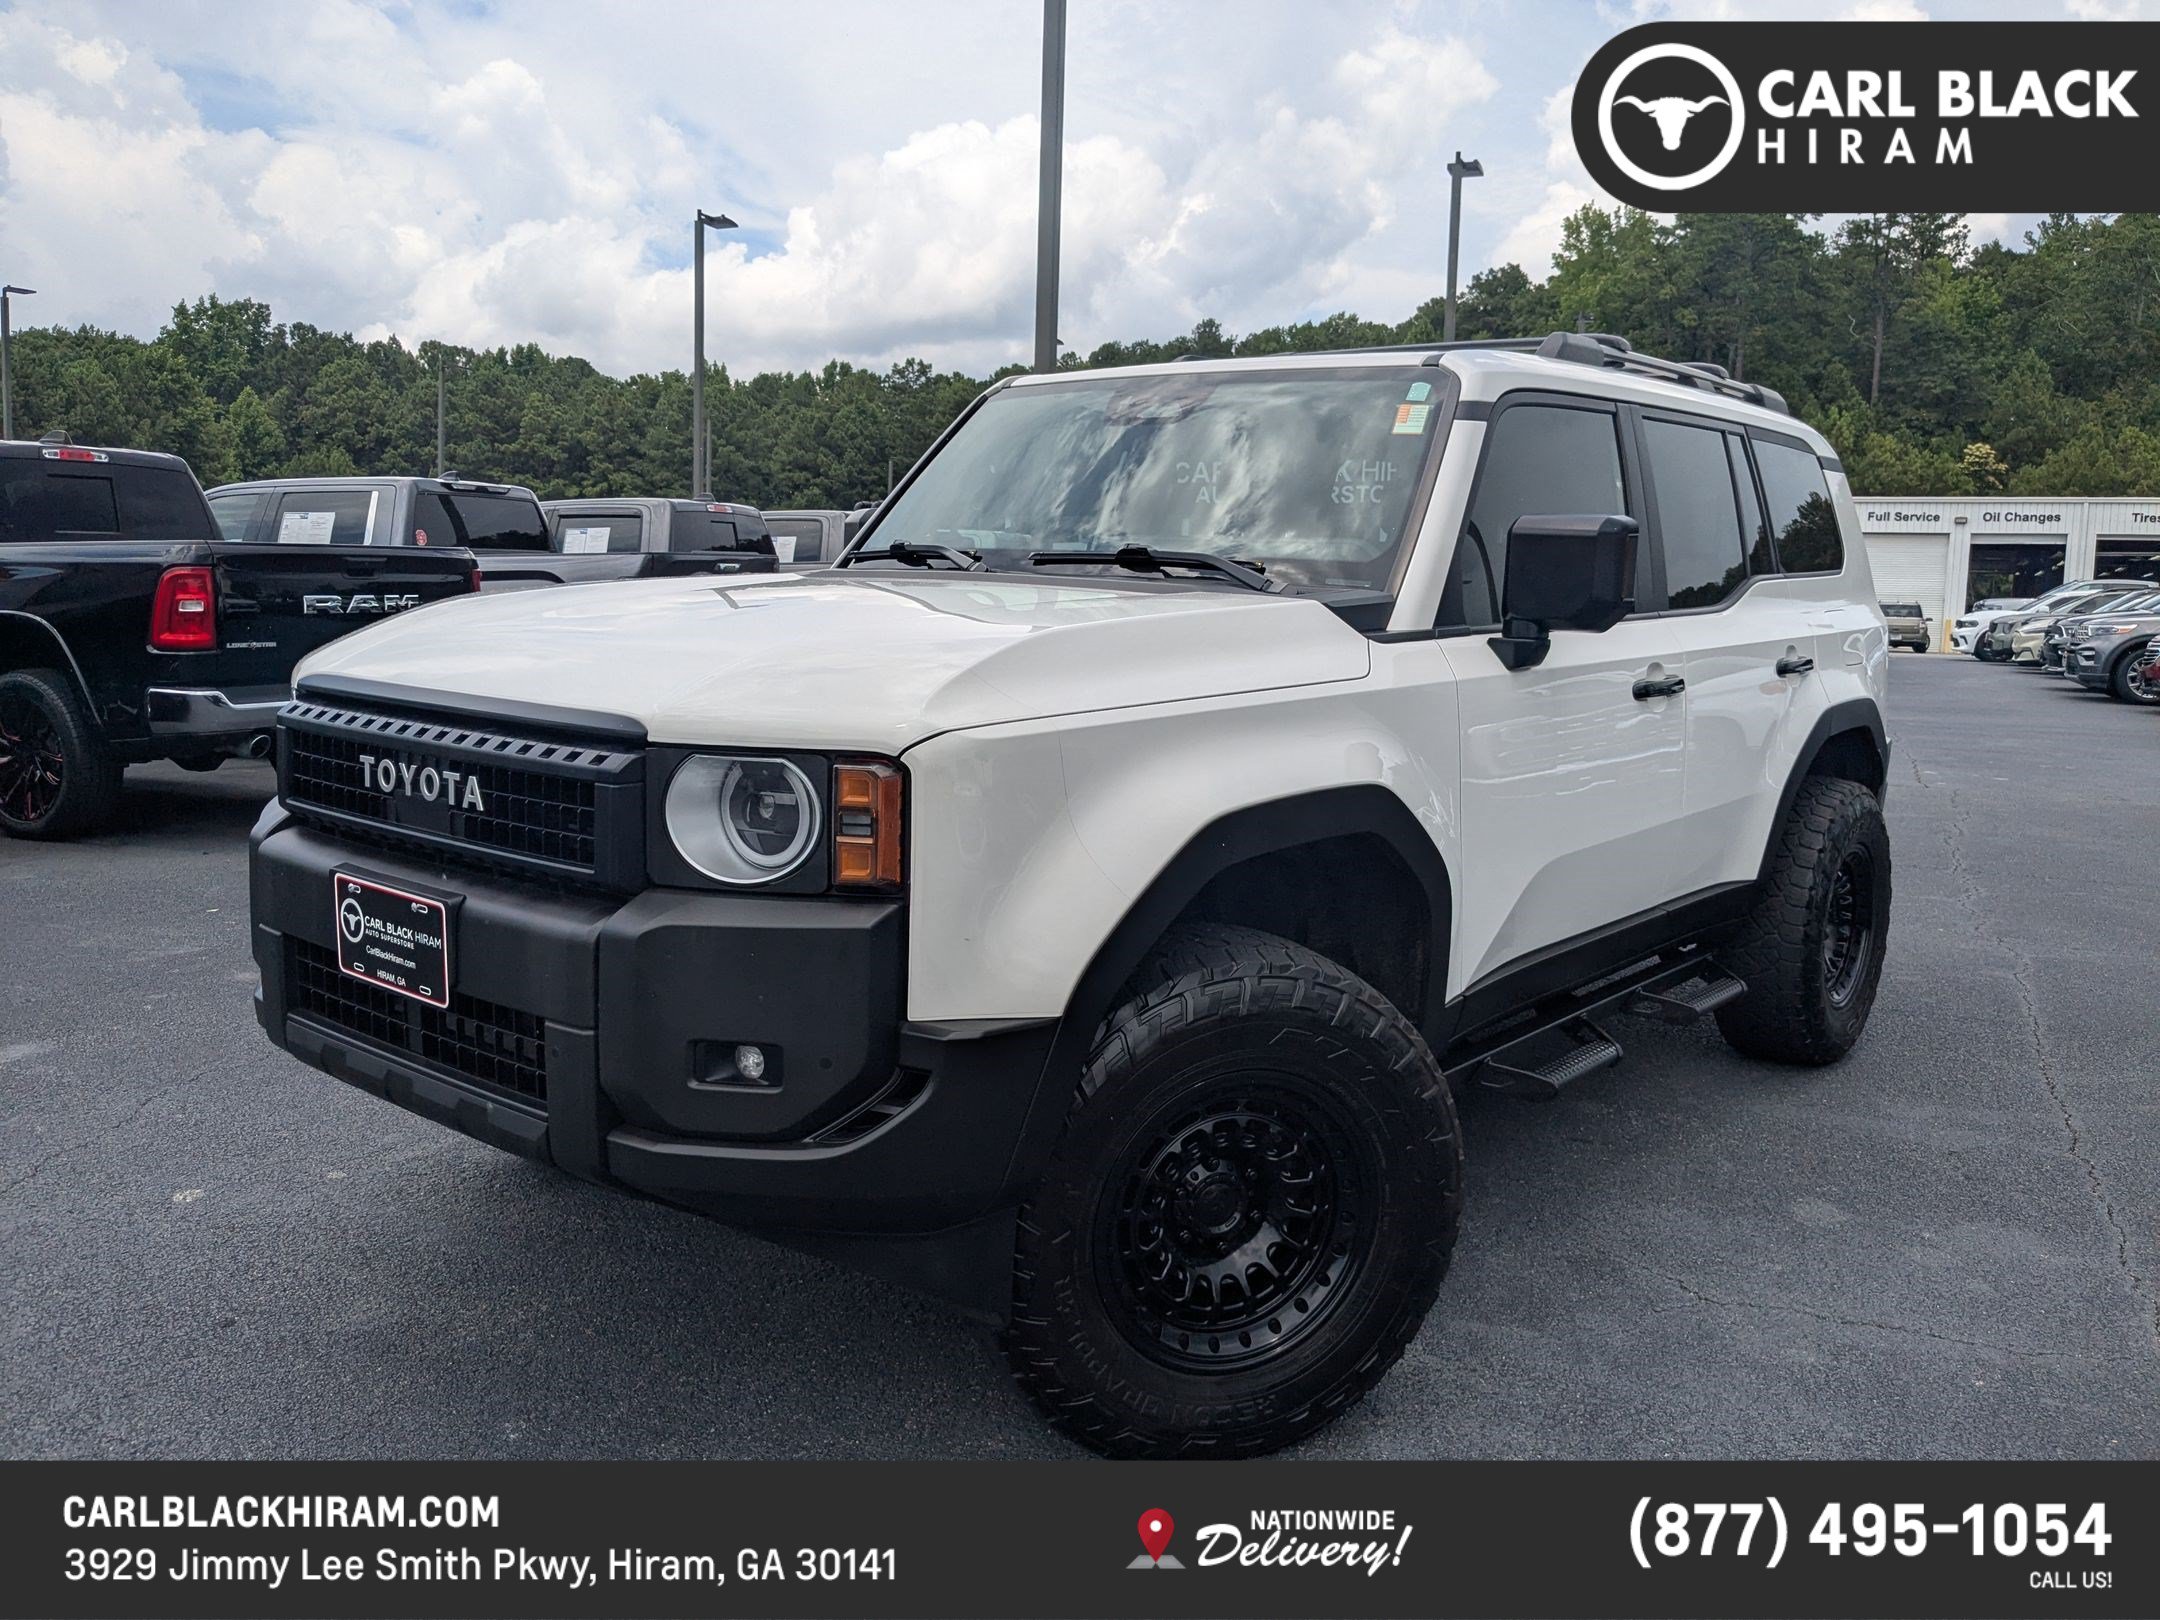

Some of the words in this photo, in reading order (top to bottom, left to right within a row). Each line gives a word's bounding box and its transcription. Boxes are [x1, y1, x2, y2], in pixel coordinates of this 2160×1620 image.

[1867, 511, 1891, 522] Full
[1894, 511, 1941, 522] Service
[1983, 512, 2001, 522] Oil
[2004, 512, 2061, 525] Changes
[359, 754, 485, 813] TOYOTA
[364, 915, 384, 932] CARL
[387, 923, 414, 940] BLACK
[414, 931, 442, 950] HIRAM
[365, 928, 380, 939] AUTO
[380, 933, 415, 950] SUPERSTORE
[376, 969, 396, 984] HIRAM,
[396, 976, 407, 987] GA
